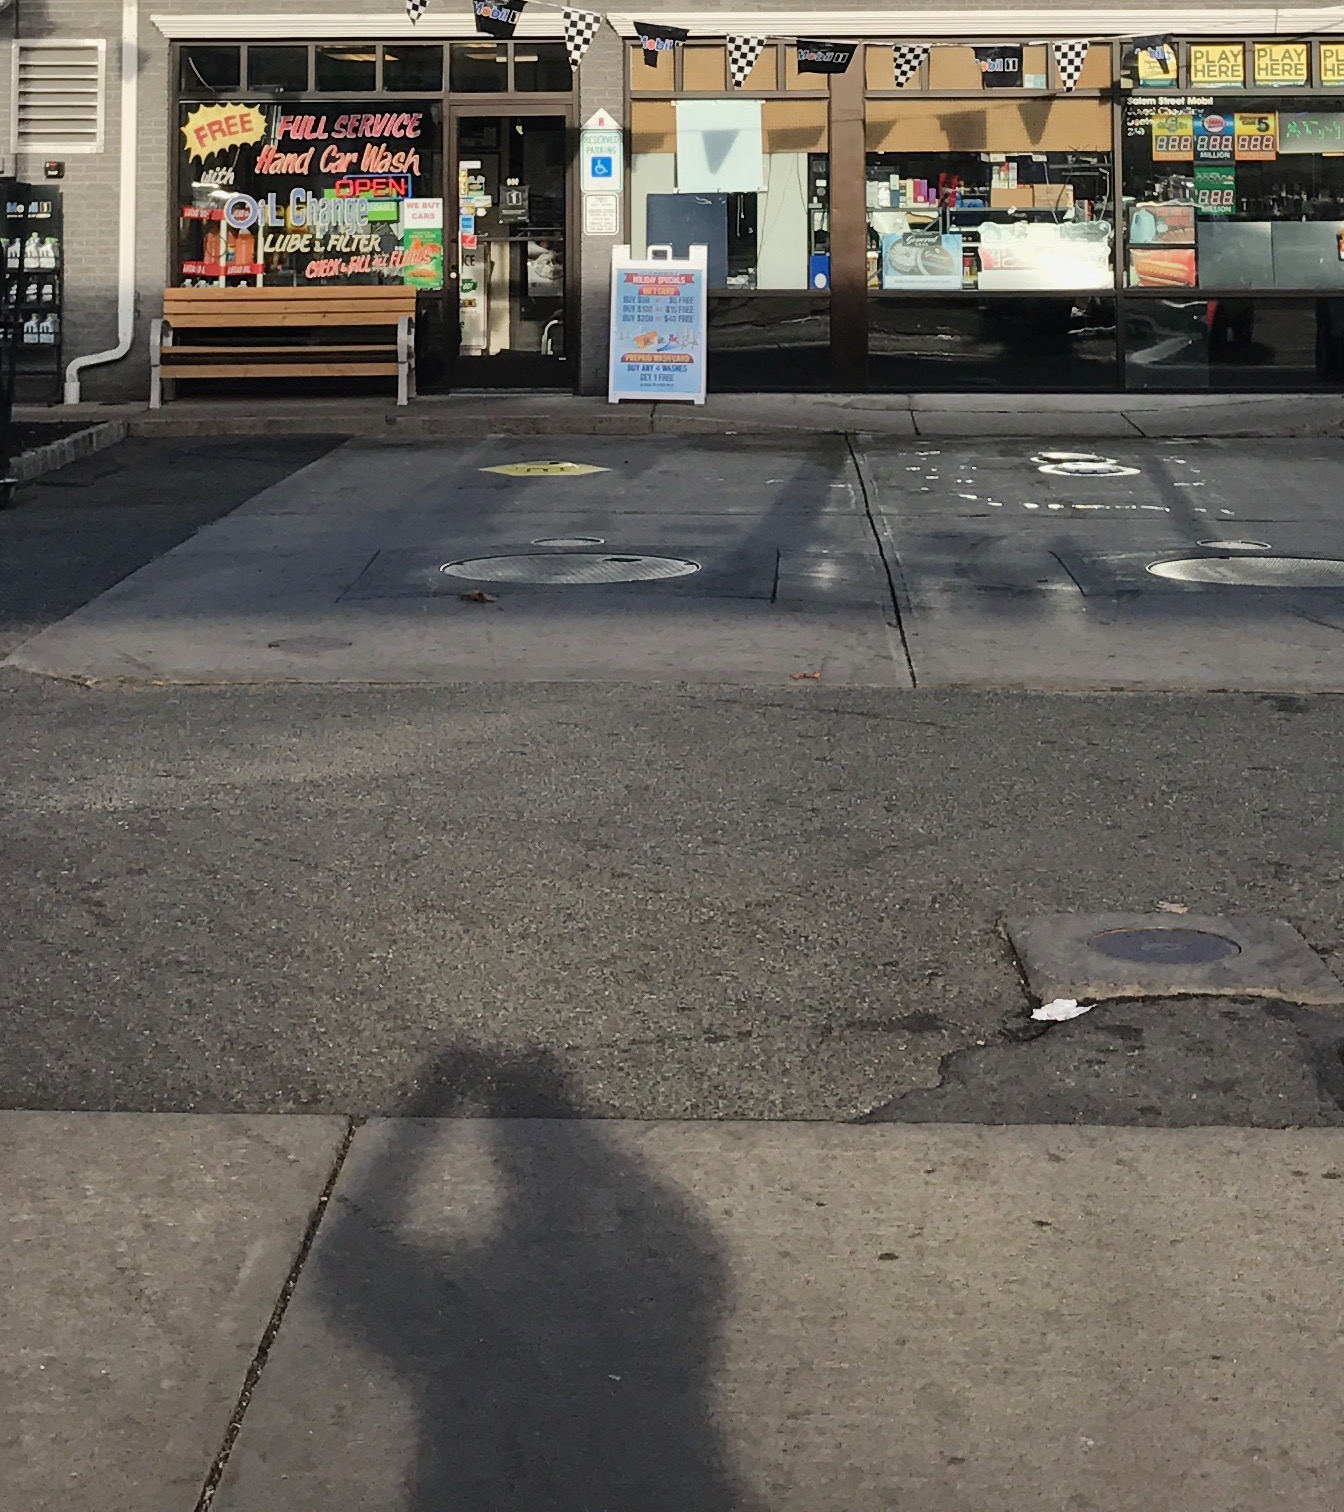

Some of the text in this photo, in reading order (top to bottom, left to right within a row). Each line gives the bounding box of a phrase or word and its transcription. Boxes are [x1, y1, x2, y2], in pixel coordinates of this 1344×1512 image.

[1193, 49, 1241, 64] PLAY
[1257, 48, 1306, 63] PLAY
[977, 58, 1003, 73] obil
[1193, 64, 1241, 78] HERE
[1257, 62, 1305, 77] HERE
[1127, 96, 1214, 106] Salem Street Mobil
[194, 113, 254, 148] FREE
[277, 112, 423, 140] FULL SERVICE
[1257, 116, 1270, 133] 5
[584, 135, 619, 144] RESERVED
[586, 146, 617, 155] PARKING
[1200, 151, 1231, 159] MILLION
[254, 143, 422, 176] Hand Car Wash
[200, 166, 236, 186] with
[335, 178, 406, 198] OPEN
[290, 187, 370, 236] Change
[411, 212, 435, 220] CARS
[264, 234, 312, 253] LUBE
[326, 234, 382, 253] FILTER
[305, 258, 343, 279] CHECK
[348, 254, 371, 276] FILL
[622, 296, 635, 304] BUY
[678, 296, 694, 304] FREE
[622, 305, 635, 313] BUY
[678, 306, 694, 314] FREE
[678, 315, 694, 323] FREE
[627, 364, 639, 372] BUY
[641, 364, 654, 372] ANY
[662, 364, 688, 372] WASHES
[640, 373, 652, 381] GET
[658, 373, 674, 381] FREE
